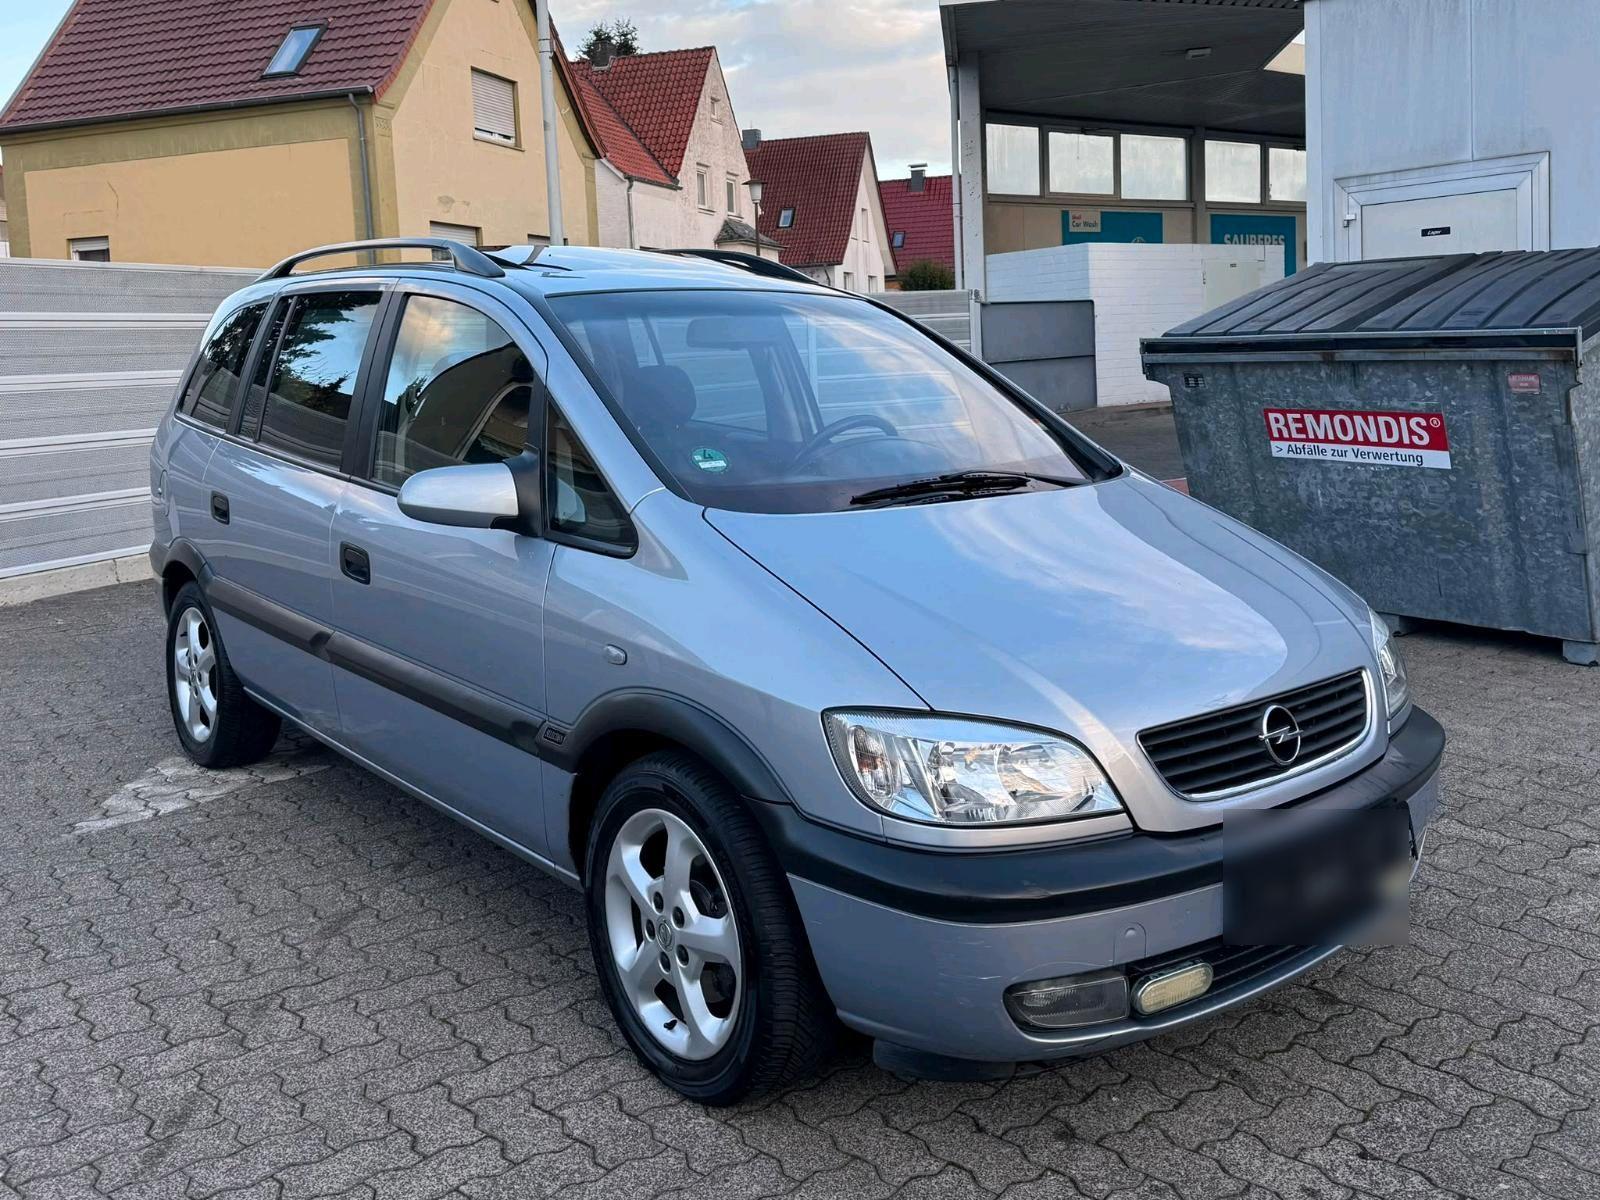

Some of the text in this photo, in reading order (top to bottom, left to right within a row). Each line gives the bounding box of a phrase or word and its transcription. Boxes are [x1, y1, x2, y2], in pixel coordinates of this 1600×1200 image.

[1071, 219, 1098, 228] Car Wash
[703, 449, 714, 459] 4
[1286, 442, 1424, 467] Abfälle zur Verwertung
